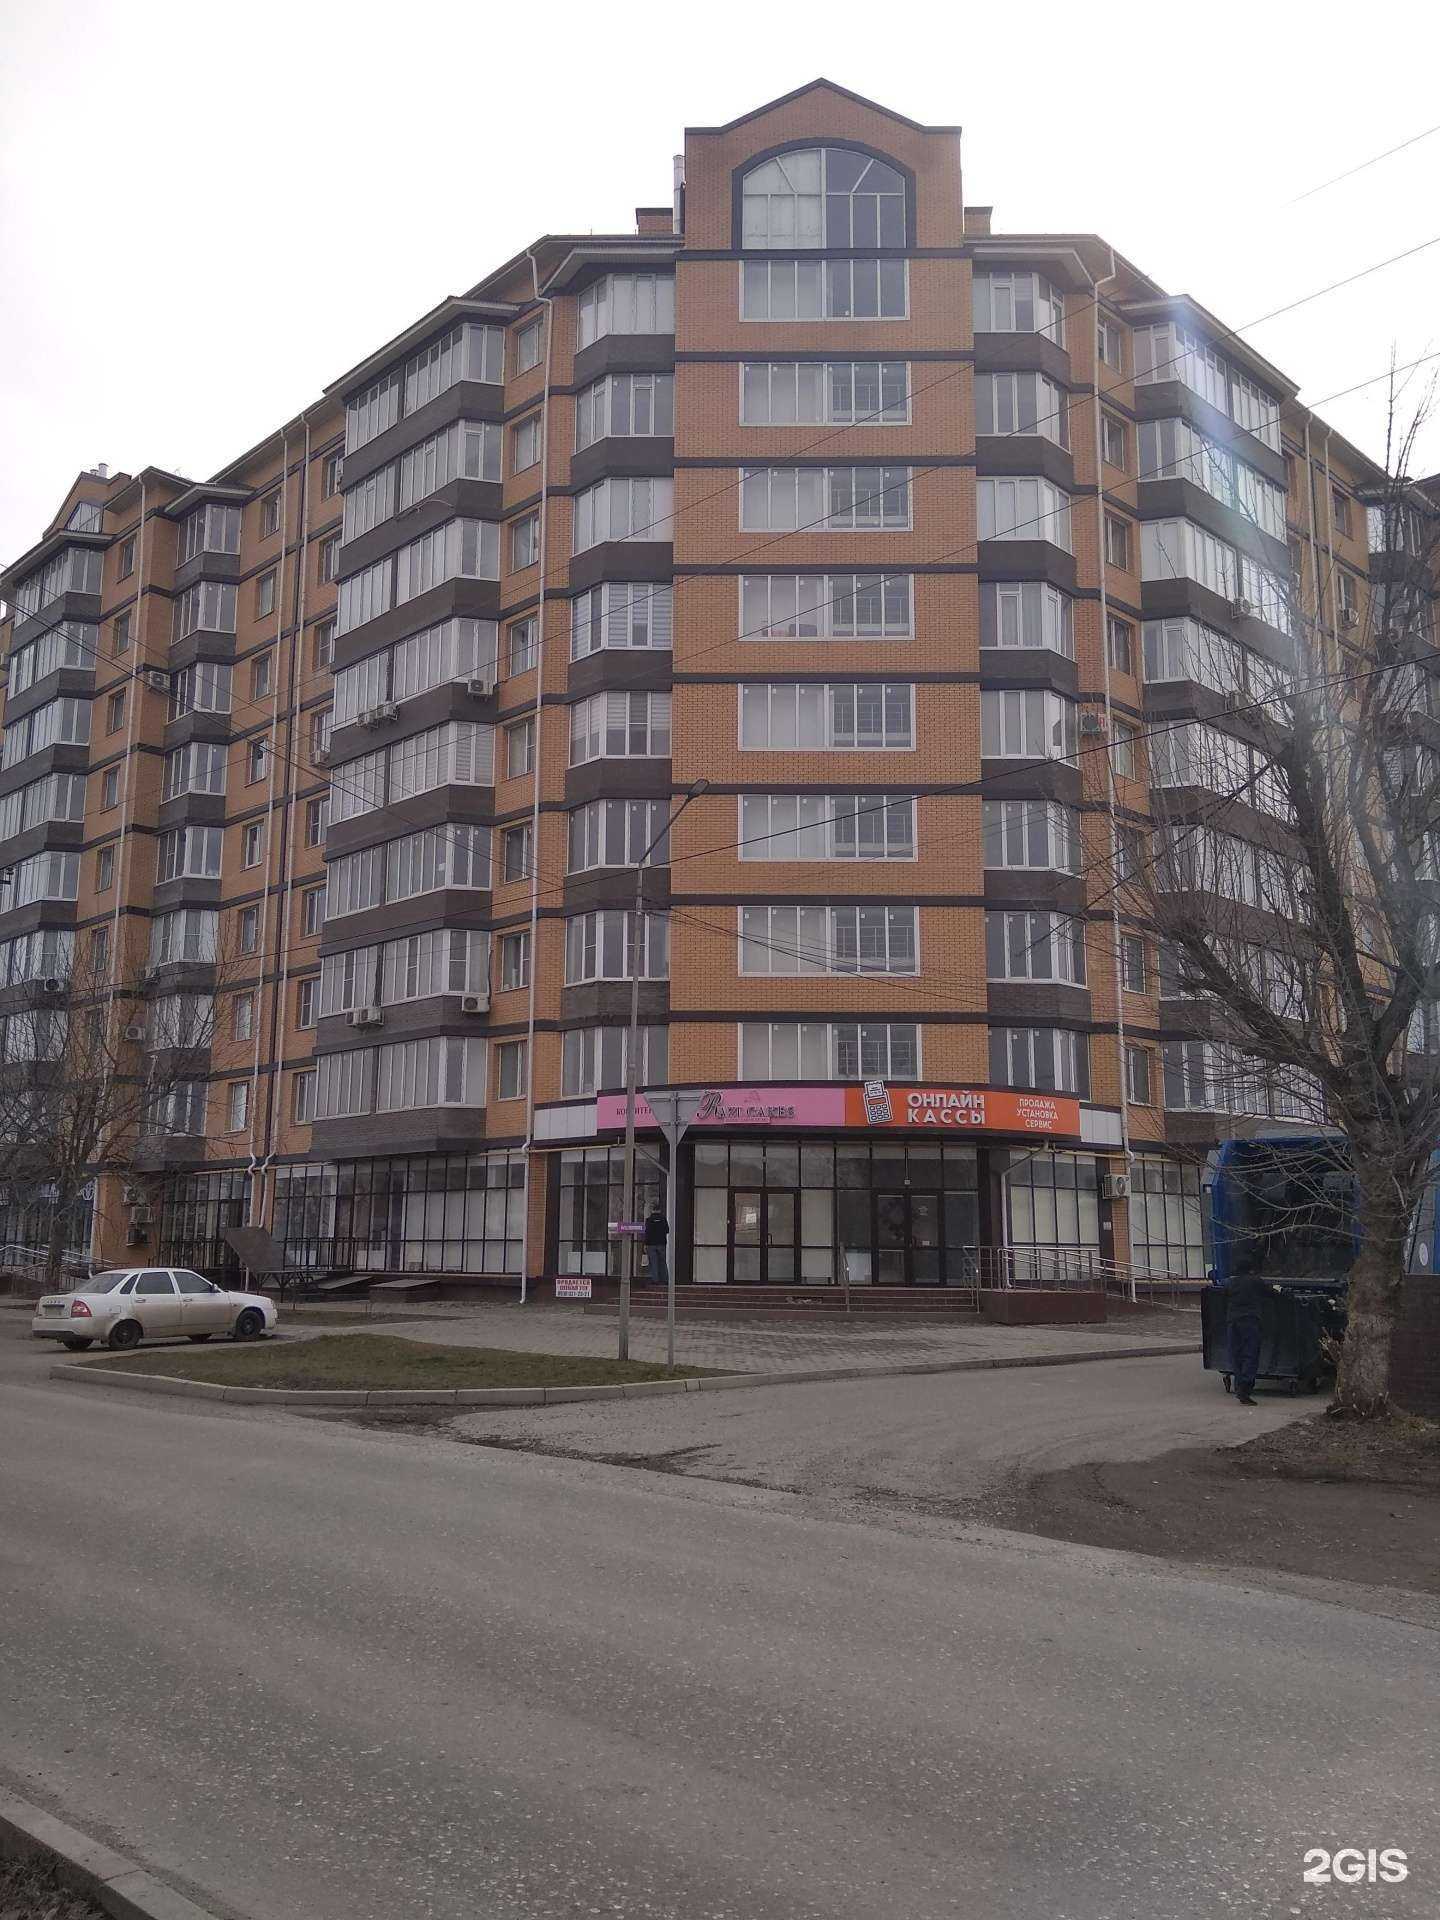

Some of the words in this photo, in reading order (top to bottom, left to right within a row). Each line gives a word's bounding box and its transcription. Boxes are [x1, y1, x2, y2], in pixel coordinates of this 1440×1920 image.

[907, 1090, 985, 1109] ОНЛАЙН
[1019, 1098, 1056, 1109] ПРОДАЖА
[907, 1108, 986, 1124] КАССЫ
[1016, 1108, 1059, 1120] УСТАНОВКА
[1025, 1119, 1052, 1129] СЕРВИС
